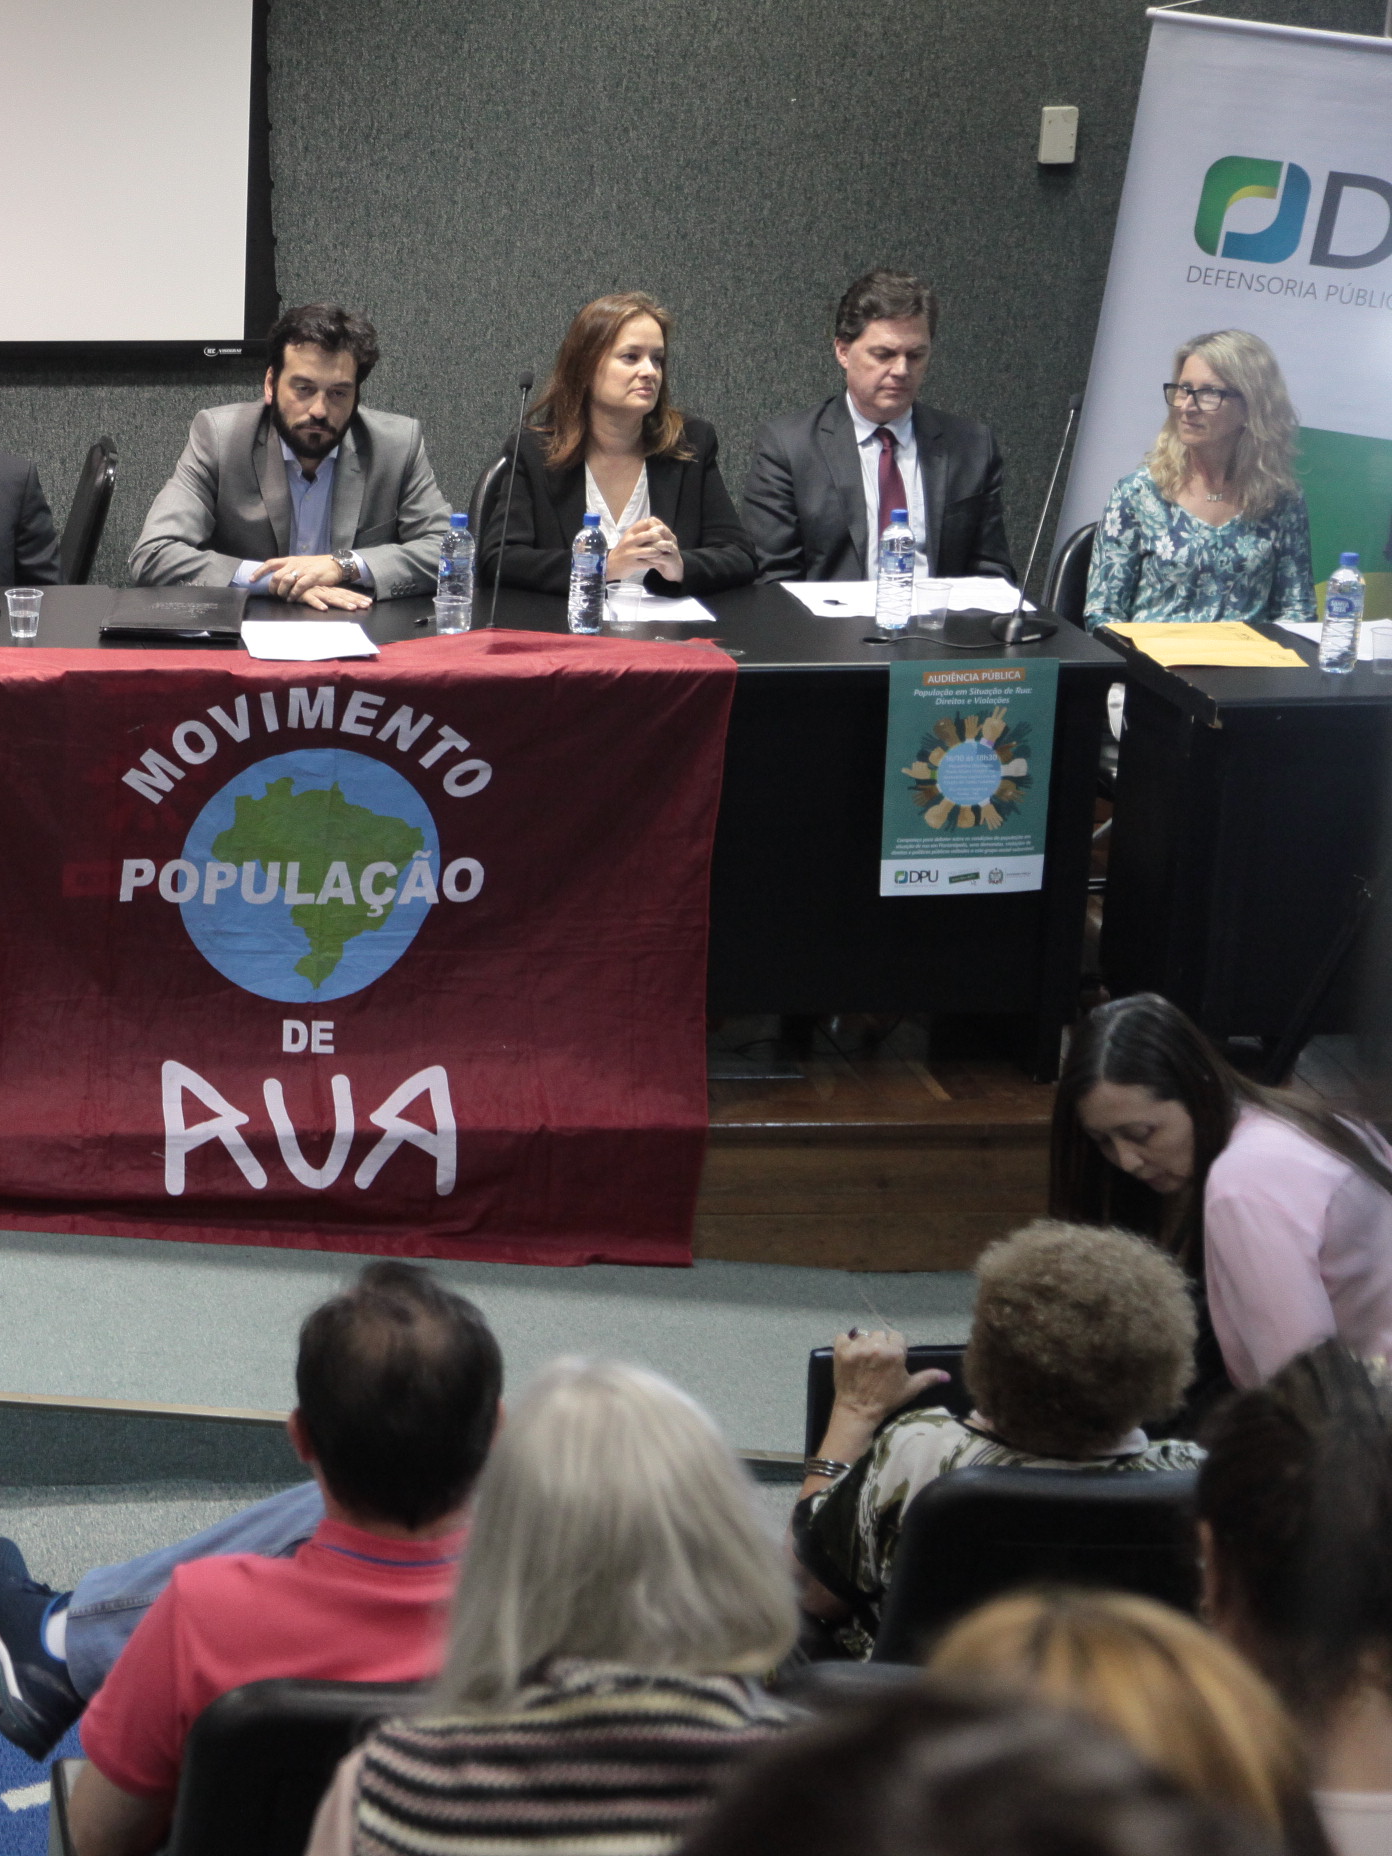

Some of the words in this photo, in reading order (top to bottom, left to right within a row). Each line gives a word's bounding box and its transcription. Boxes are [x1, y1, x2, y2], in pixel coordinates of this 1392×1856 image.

[1186, 265, 1318, 300] DEFENSORIA
[927, 672, 980, 683] AUDIÊNCIA
[982, 670, 1021, 681] PÚBLICA
[914, 689, 953, 698] População
[969, 688, 1002, 696] Situação
[974, 697, 1010, 705] Violações
[120, 684, 495, 806] MOVIMENTO
[118, 849, 486, 918] POPULAÇÃO
[909, 870, 939, 883] DPU
[282, 1019, 335, 1055] DE
